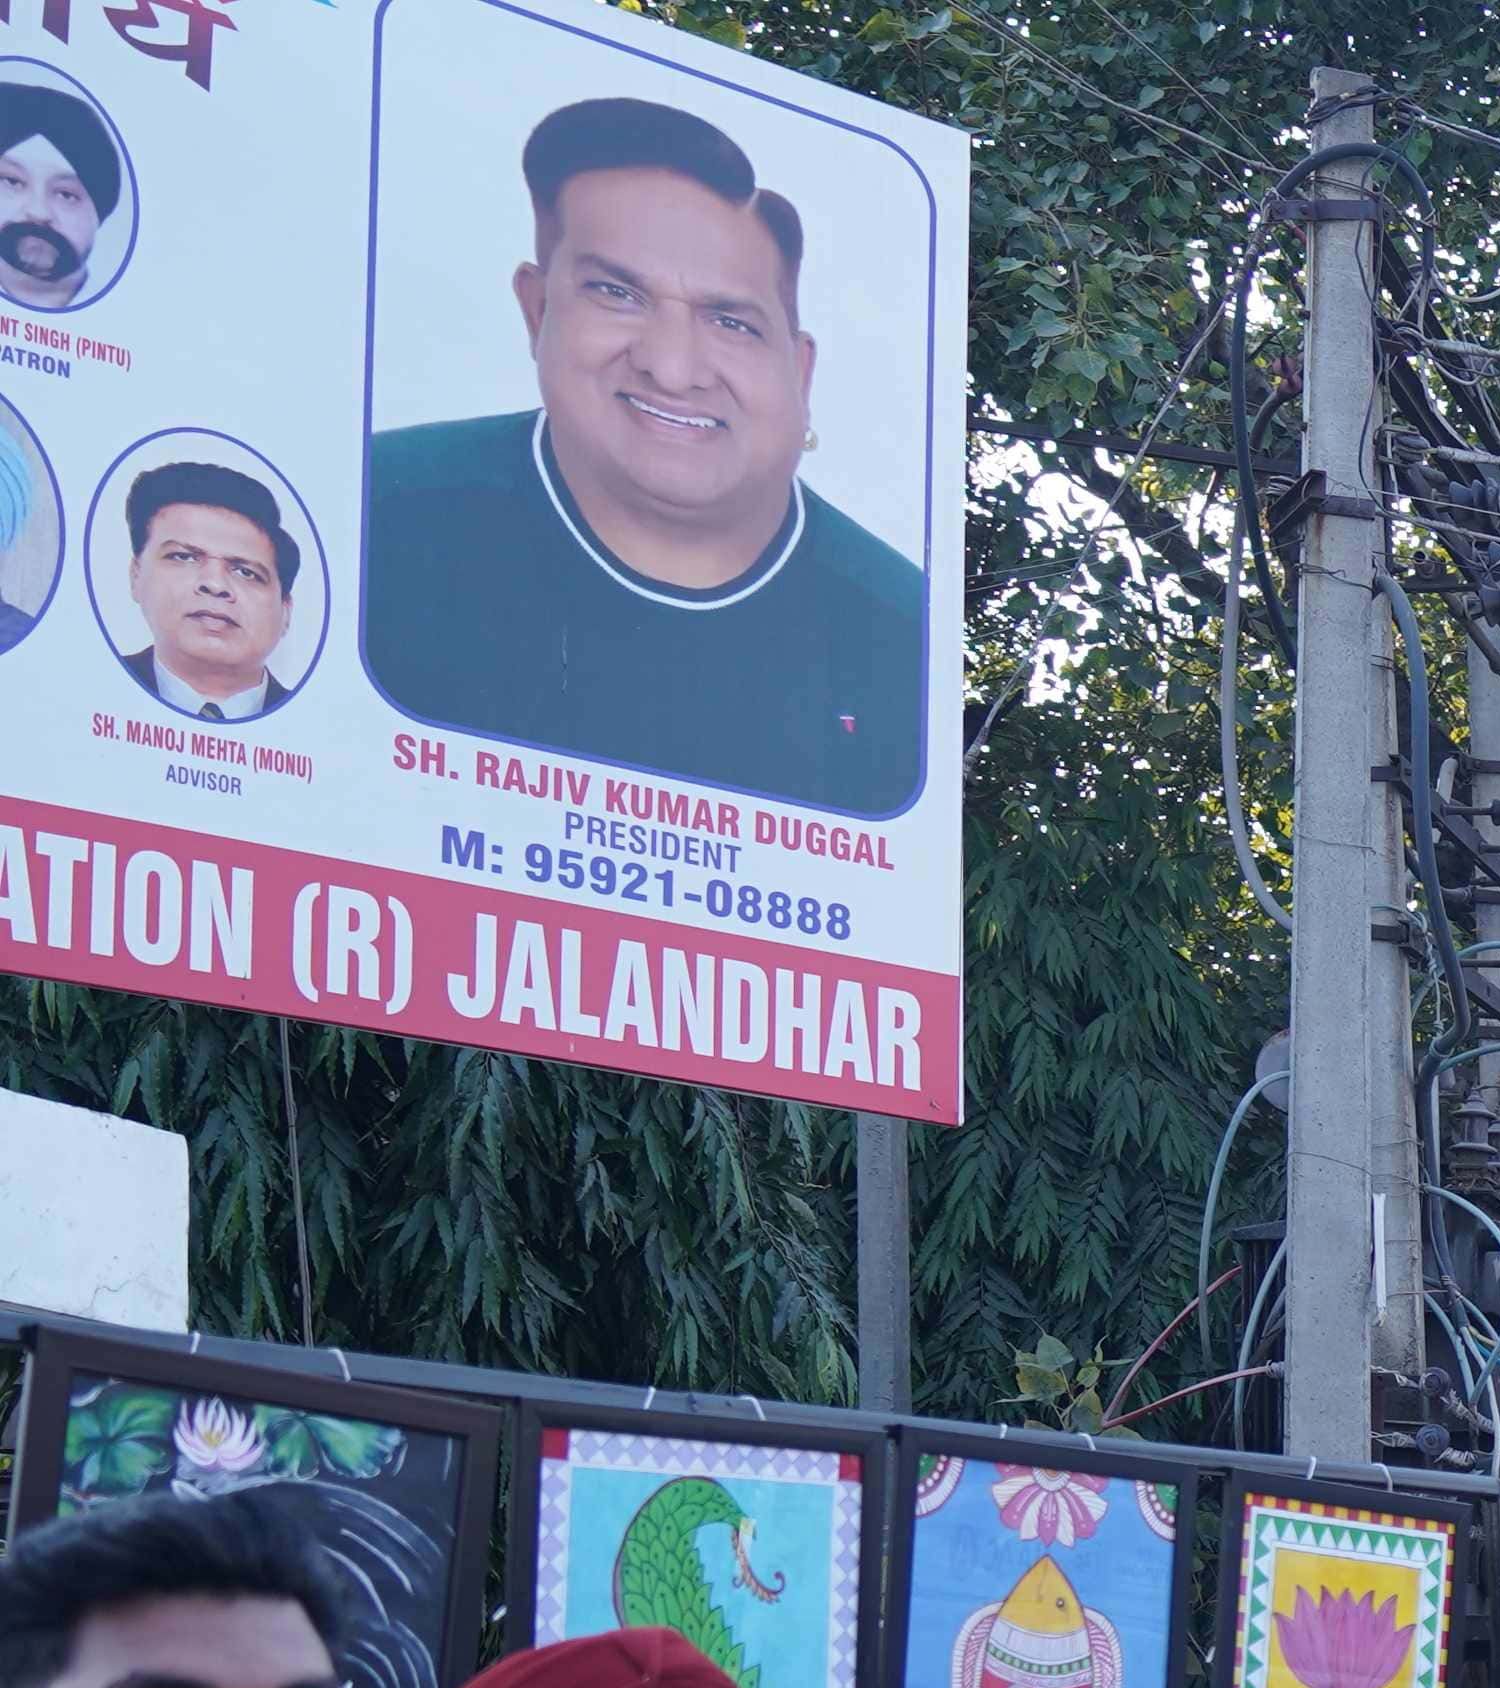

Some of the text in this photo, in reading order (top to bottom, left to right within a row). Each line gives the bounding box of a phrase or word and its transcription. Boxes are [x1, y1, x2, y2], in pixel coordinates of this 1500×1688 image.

[0, 344, 70, 378] ATRON
[24, 322, 70, 352] SINGH
[76, 336, 131, 373] (PINTU)
[92, 713, 313, 784] SH. MANOJ MEHTA (MONU)
[166, 764, 242, 796] ADVISOR
[393, 733, 894, 870] SH. RAJIV KUMAR DUGGAL
[564, 811, 742, 873] PRESIDENT
[441, 825, 851, 941] M: 95921-08888
[292, 882, 413, 1016] (R)
[447, 912, 922, 1092] JALANDHAR
